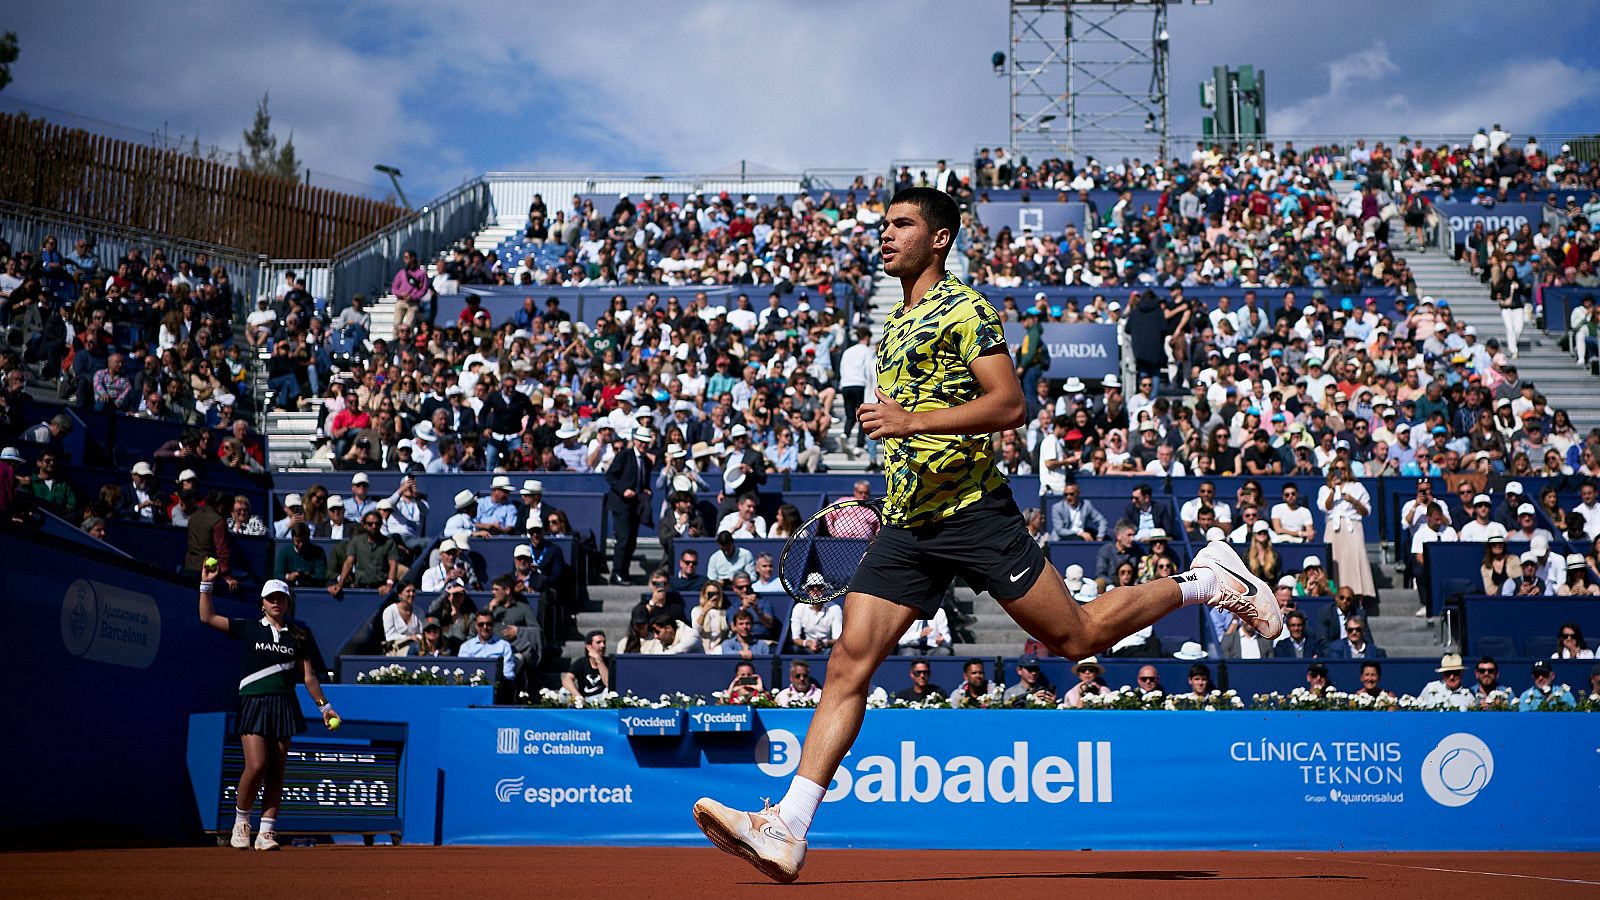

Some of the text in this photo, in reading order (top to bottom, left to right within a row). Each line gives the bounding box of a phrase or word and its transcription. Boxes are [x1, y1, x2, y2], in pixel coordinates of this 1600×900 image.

[1046, 343, 1108, 359] UARDIA
[101, 620, 148, 646] Barcelona
[255, 642, 294, 656] MANGO
[632, 717, 675, 727] Occident
[703, 713, 747, 723] Occident
[524, 729, 591, 741] Generalitat
[524, 743, 604, 757] de Catalunya
[768, 741, 788, 765] B
[1230, 737, 1402, 762] CLÍNICA TENIS
[1299, 765, 1403, 784] TEKNON
[524, 784, 633, 808] esportcat
[1304, 794, 1327, 803] Grupo
